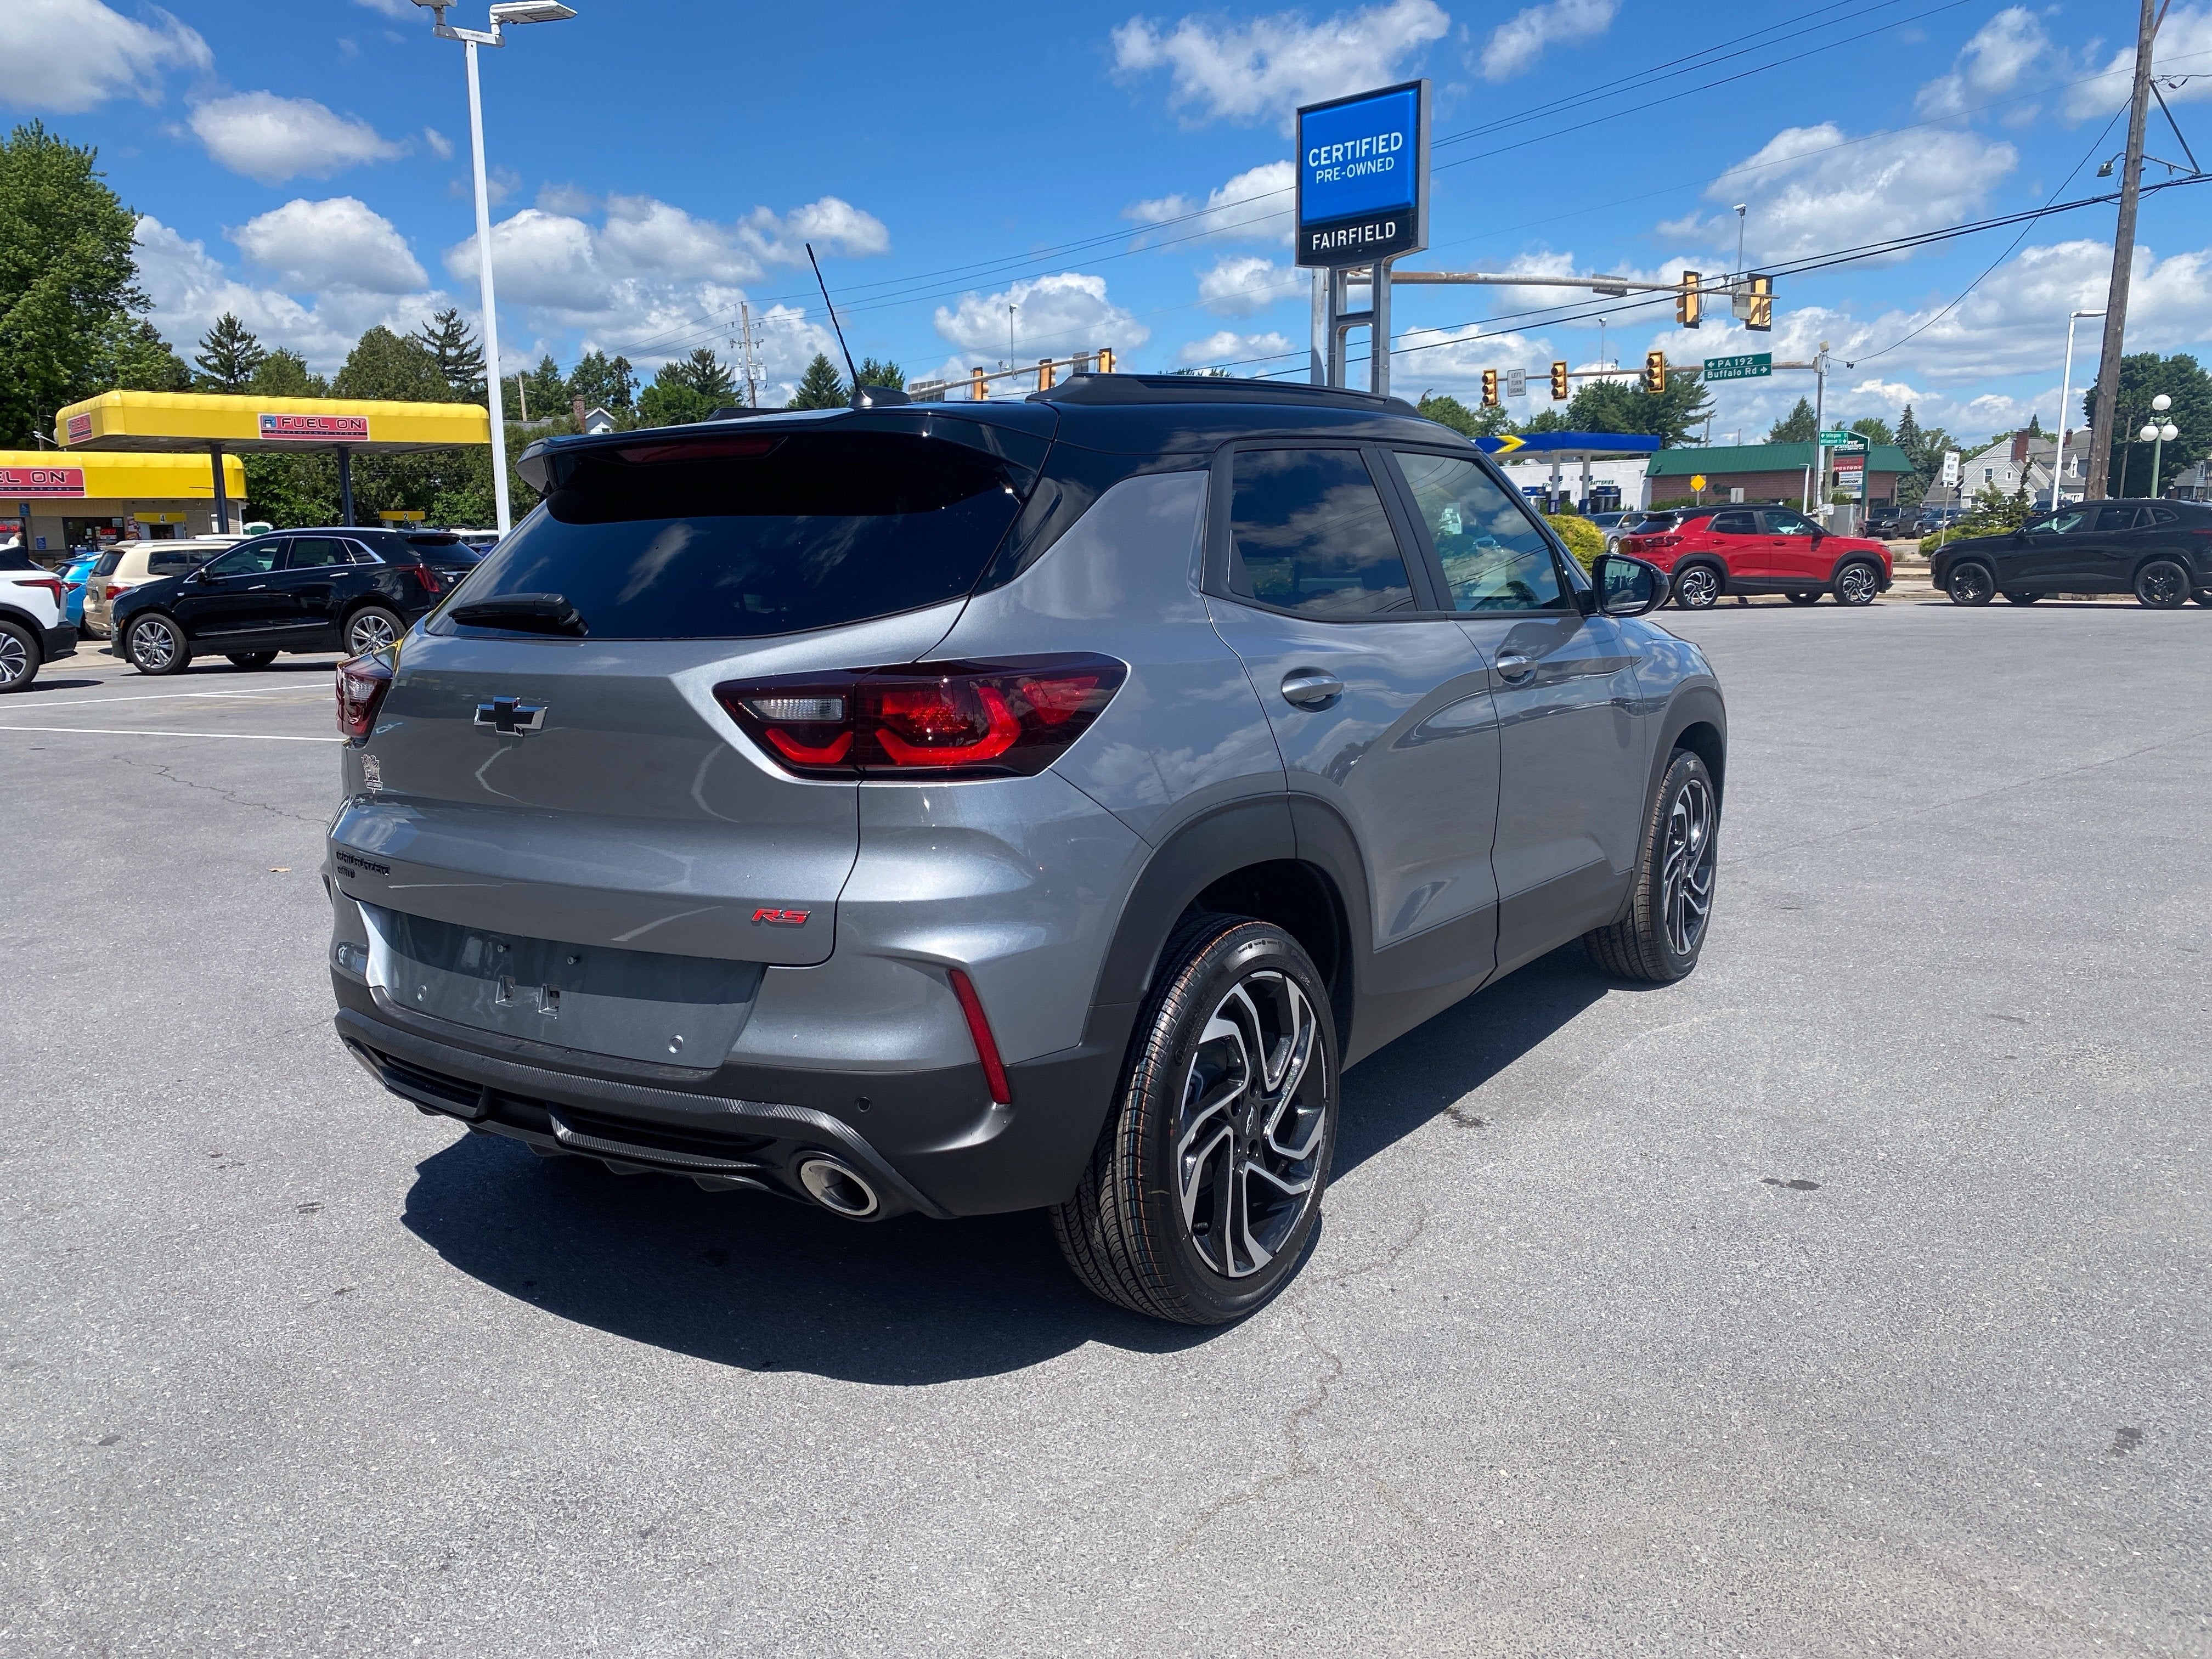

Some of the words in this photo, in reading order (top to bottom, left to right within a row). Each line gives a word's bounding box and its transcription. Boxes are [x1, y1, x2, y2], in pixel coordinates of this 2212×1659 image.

[1308, 132, 1403, 167] CERTIFIED
[1316, 157, 1395, 184] PRE-OWNED
[1312, 222, 1396, 251] FAIRFIELD
[1718, 359, 1731, 368] PA
[1735, 357, 1753, 366] 192
[1707, 369, 1742, 379] Buffalo
[1745, 366, 1757, 375] Rd
[281, 417, 329, 429] FUEL
[336, 419, 363, 430] ON
[30, 471, 65, 484] ON
[751, 908, 811, 924] RS
